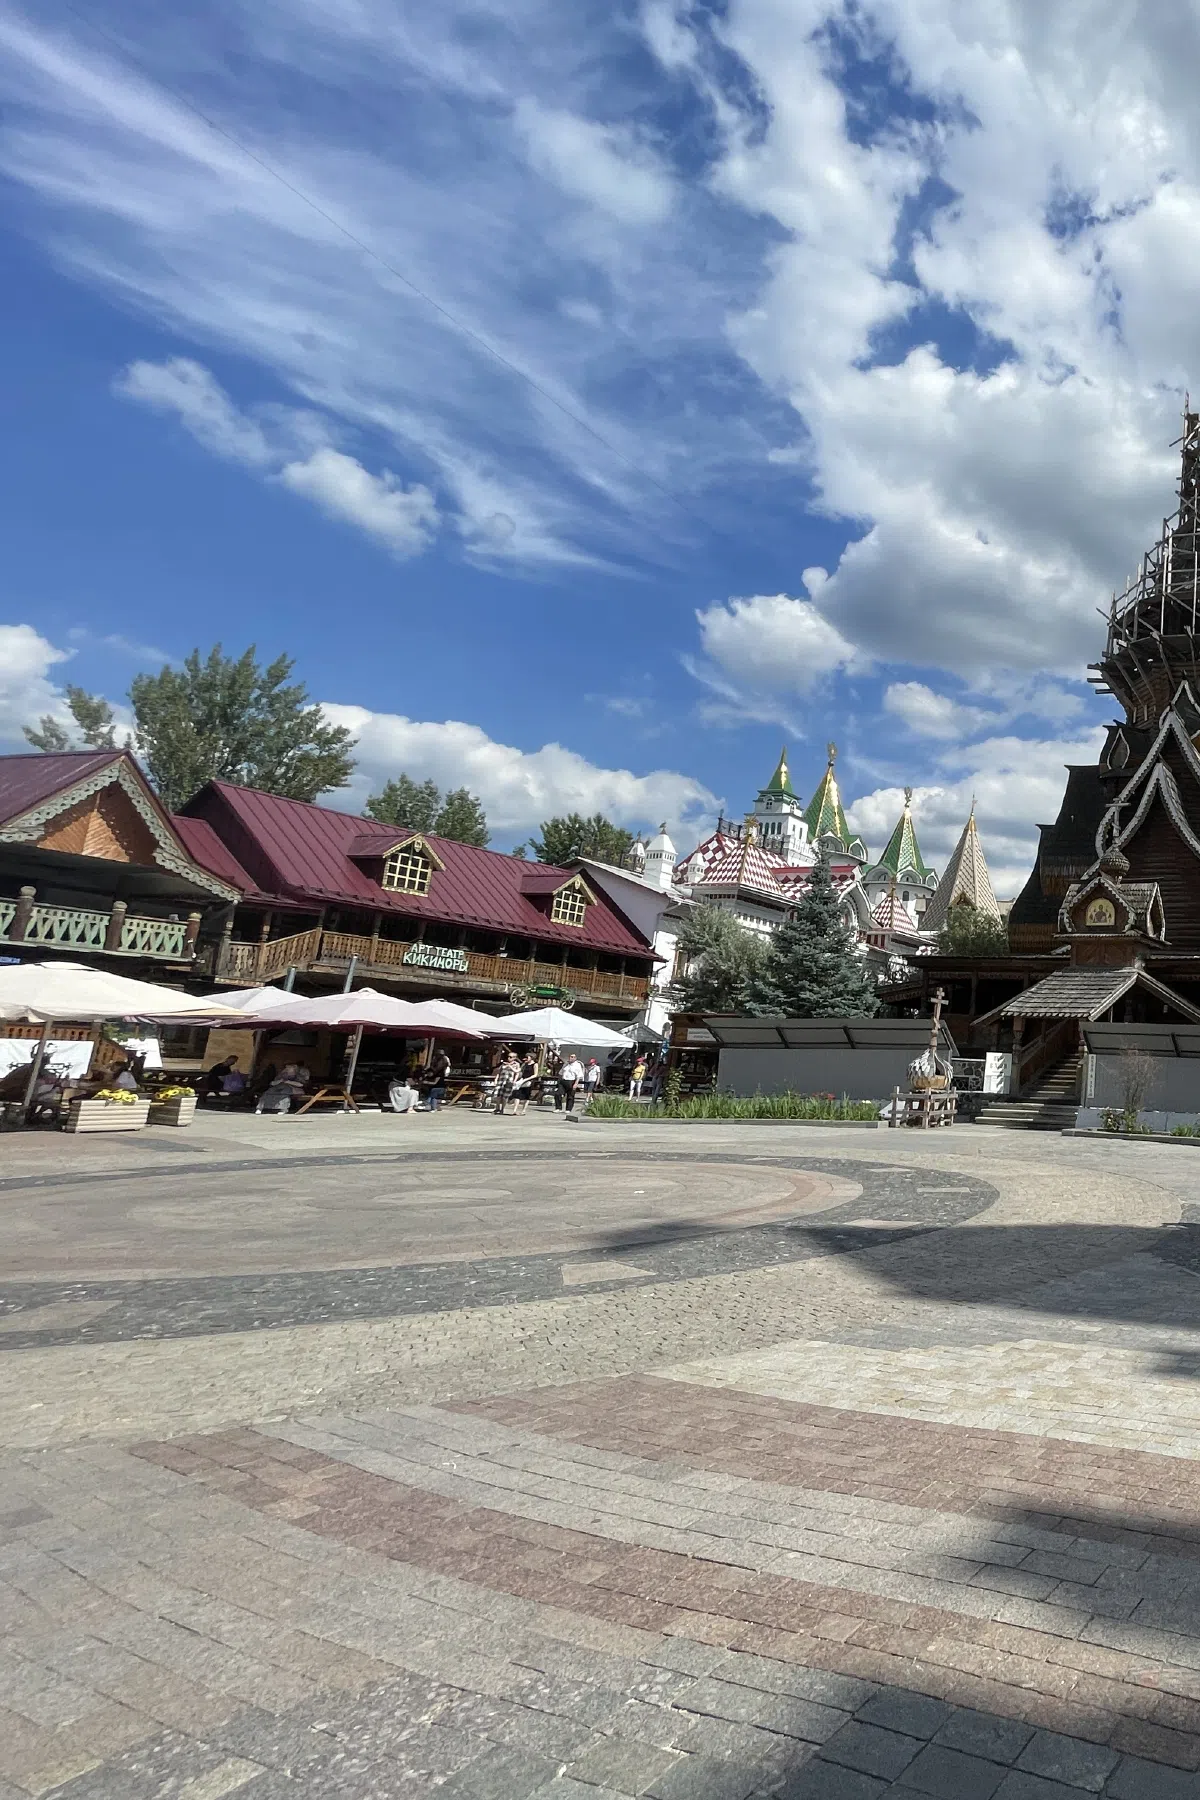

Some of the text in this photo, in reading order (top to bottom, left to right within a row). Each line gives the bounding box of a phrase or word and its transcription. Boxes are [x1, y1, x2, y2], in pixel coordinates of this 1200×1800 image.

[411, 943, 464, 959] АРТ ТЕАТР
[403, 952, 469, 971] КИКИМОРЫ
